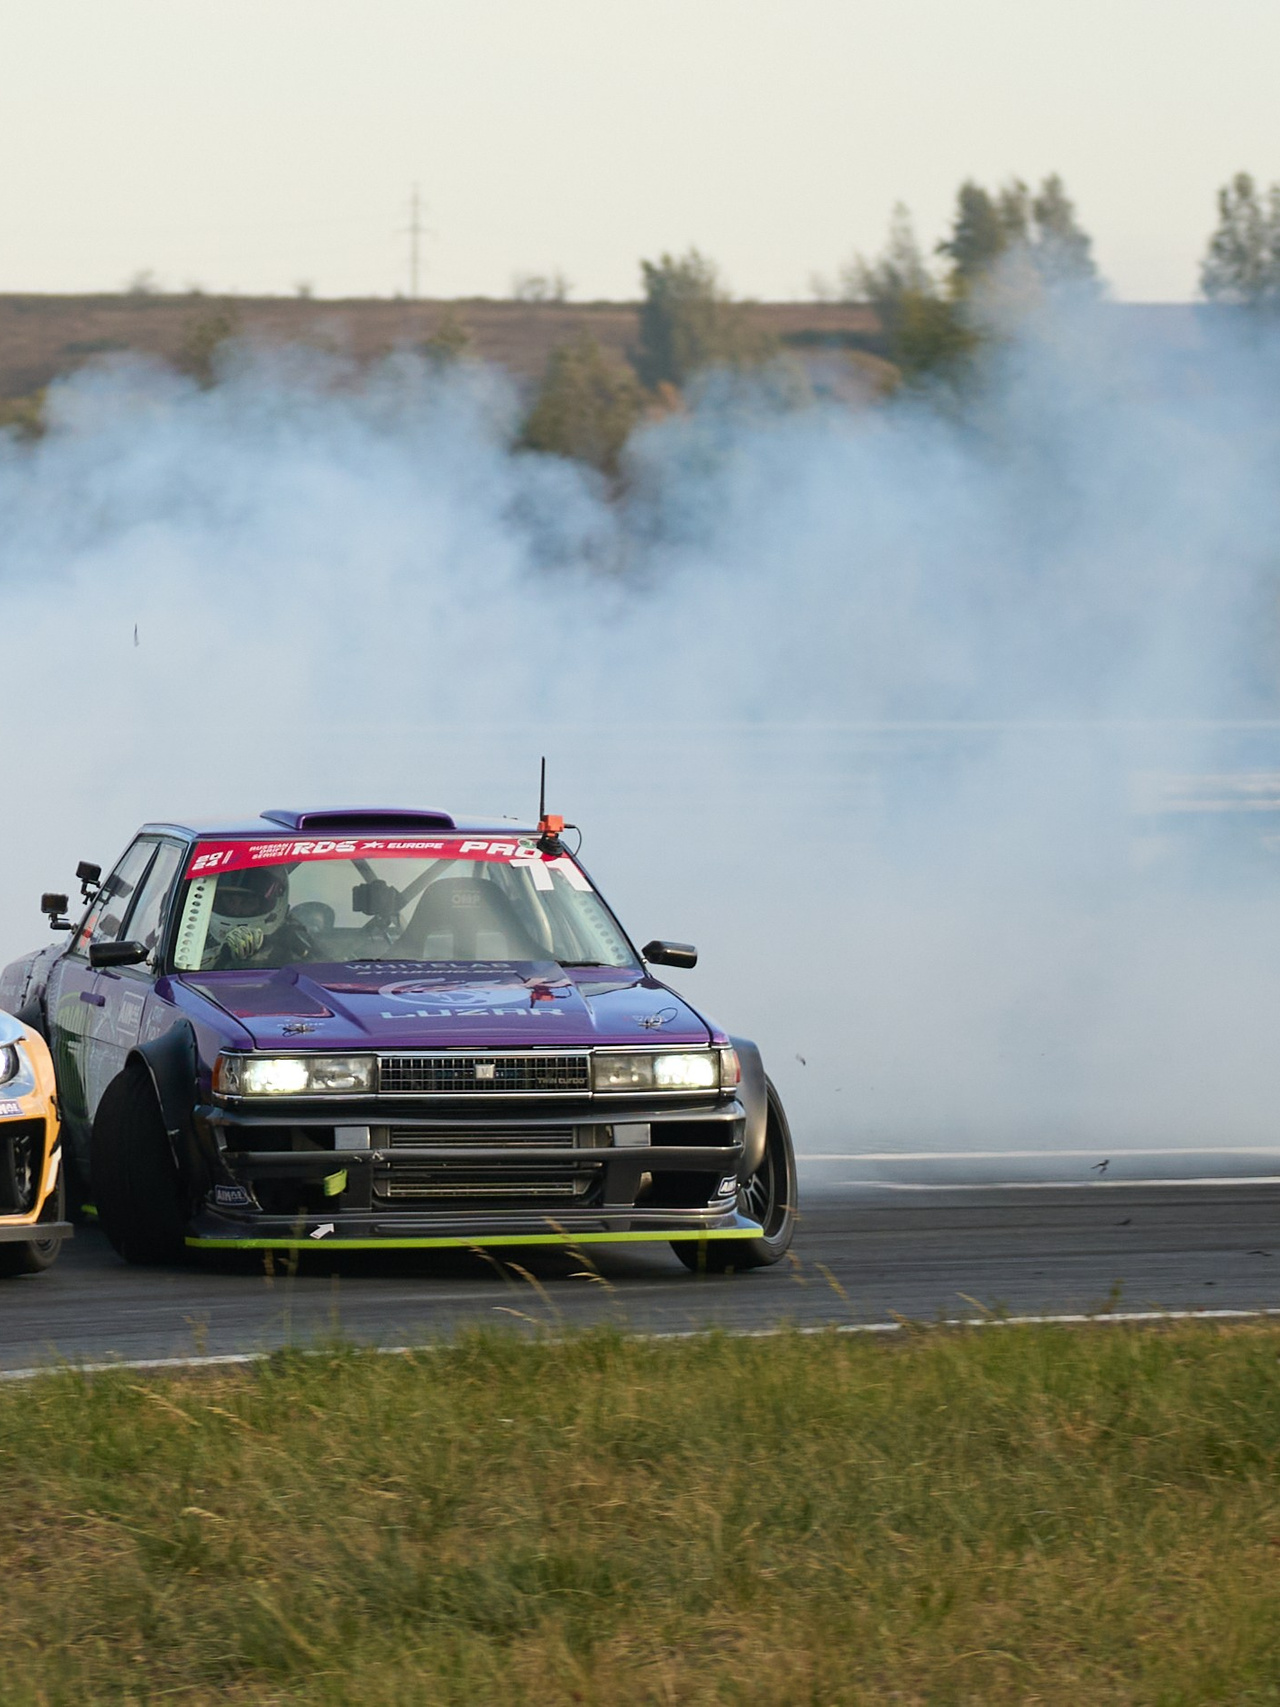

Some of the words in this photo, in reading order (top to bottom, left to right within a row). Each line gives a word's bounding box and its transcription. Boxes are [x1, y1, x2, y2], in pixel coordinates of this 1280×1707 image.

[249, 843, 289, 852] RUSSIAN
[386, 842, 444, 850] EUROPE
[459, 841, 543, 859] PRO
[380, 1007, 565, 1019] LUZAR
